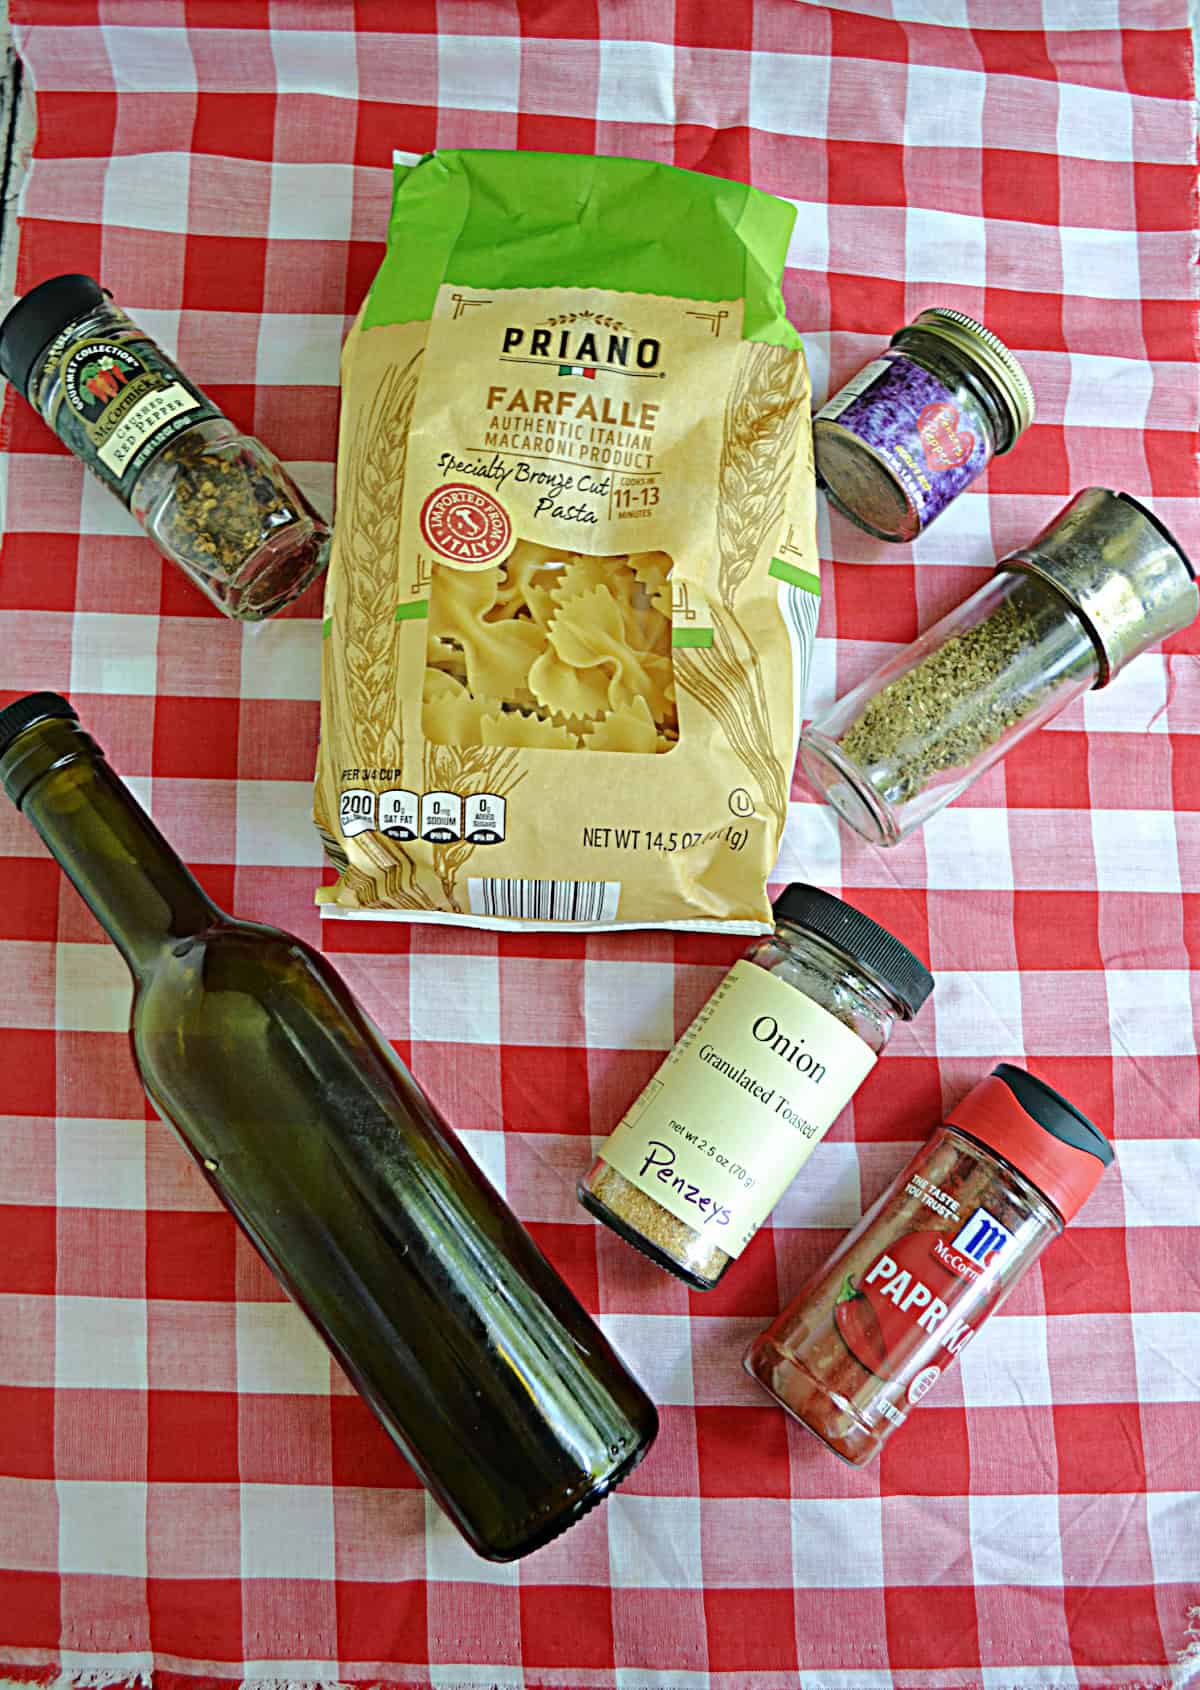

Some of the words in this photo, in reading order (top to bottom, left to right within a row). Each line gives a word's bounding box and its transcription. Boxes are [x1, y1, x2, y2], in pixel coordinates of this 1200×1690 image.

[65, 361, 85, 411] GOURMET
[116, 396, 164, 439] CRUSHED
[486, 385, 660, 432] FARFALLE
[113, 435, 136, 461] RED
[135, 399, 185, 433] PEPPER
[489, 415, 584, 441] AUTHENTIC
[589, 428, 653, 451] ITALIAN
[484, 431, 574, 456] MACARONI
[579, 444, 654, 469] PRODUCT
[437, 451, 513, 492] Specialty
[514, 462, 574, 498] Bronze
[577, 474, 612, 498] Cut
[431, 492, 486, 527] IMPORTED
[484, 504, 503, 540] FROM
[533, 496, 599, 524] Pasta
[613, 486, 661, 508] 11-13
[441, 535, 490, 556] ITALY
[341, 768, 360, 781] PER
[361, 768, 378, 781] 3/4
[379, 768, 402, 782] CUP
[342, 795, 372, 815] 200
[384, 814, 397, 824] SAT
[400, 815, 413, 824] FAT
[426, 816, 456, 825] SODIUM
[583, 826, 611, 848] NET
[614, 828, 641, 849] WT
[645, 831, 678, 852] 14.5
[751, 1015, 828, 1085] Onion
[698, 1044, 776, 1105] Granulated
[773, 1096, 820, 1140] Toasted
[668, 1119, 686, 1135] net
[685, 1131, 698, 1145] wt
[697, 1139, 716, 1157] 2.5
[715, 1154, 729, 1167] oz
[729, 1163, 747, 1180] (70
[639, 1140, 732, 1226] Penzeys
[904, 1183, 922, 1198] YOU
[911, 1174, 929, 1189] THE
[928, 1185, 960, 1212] TASTE
[865, 1255, 975, 1355] PAPRKA
